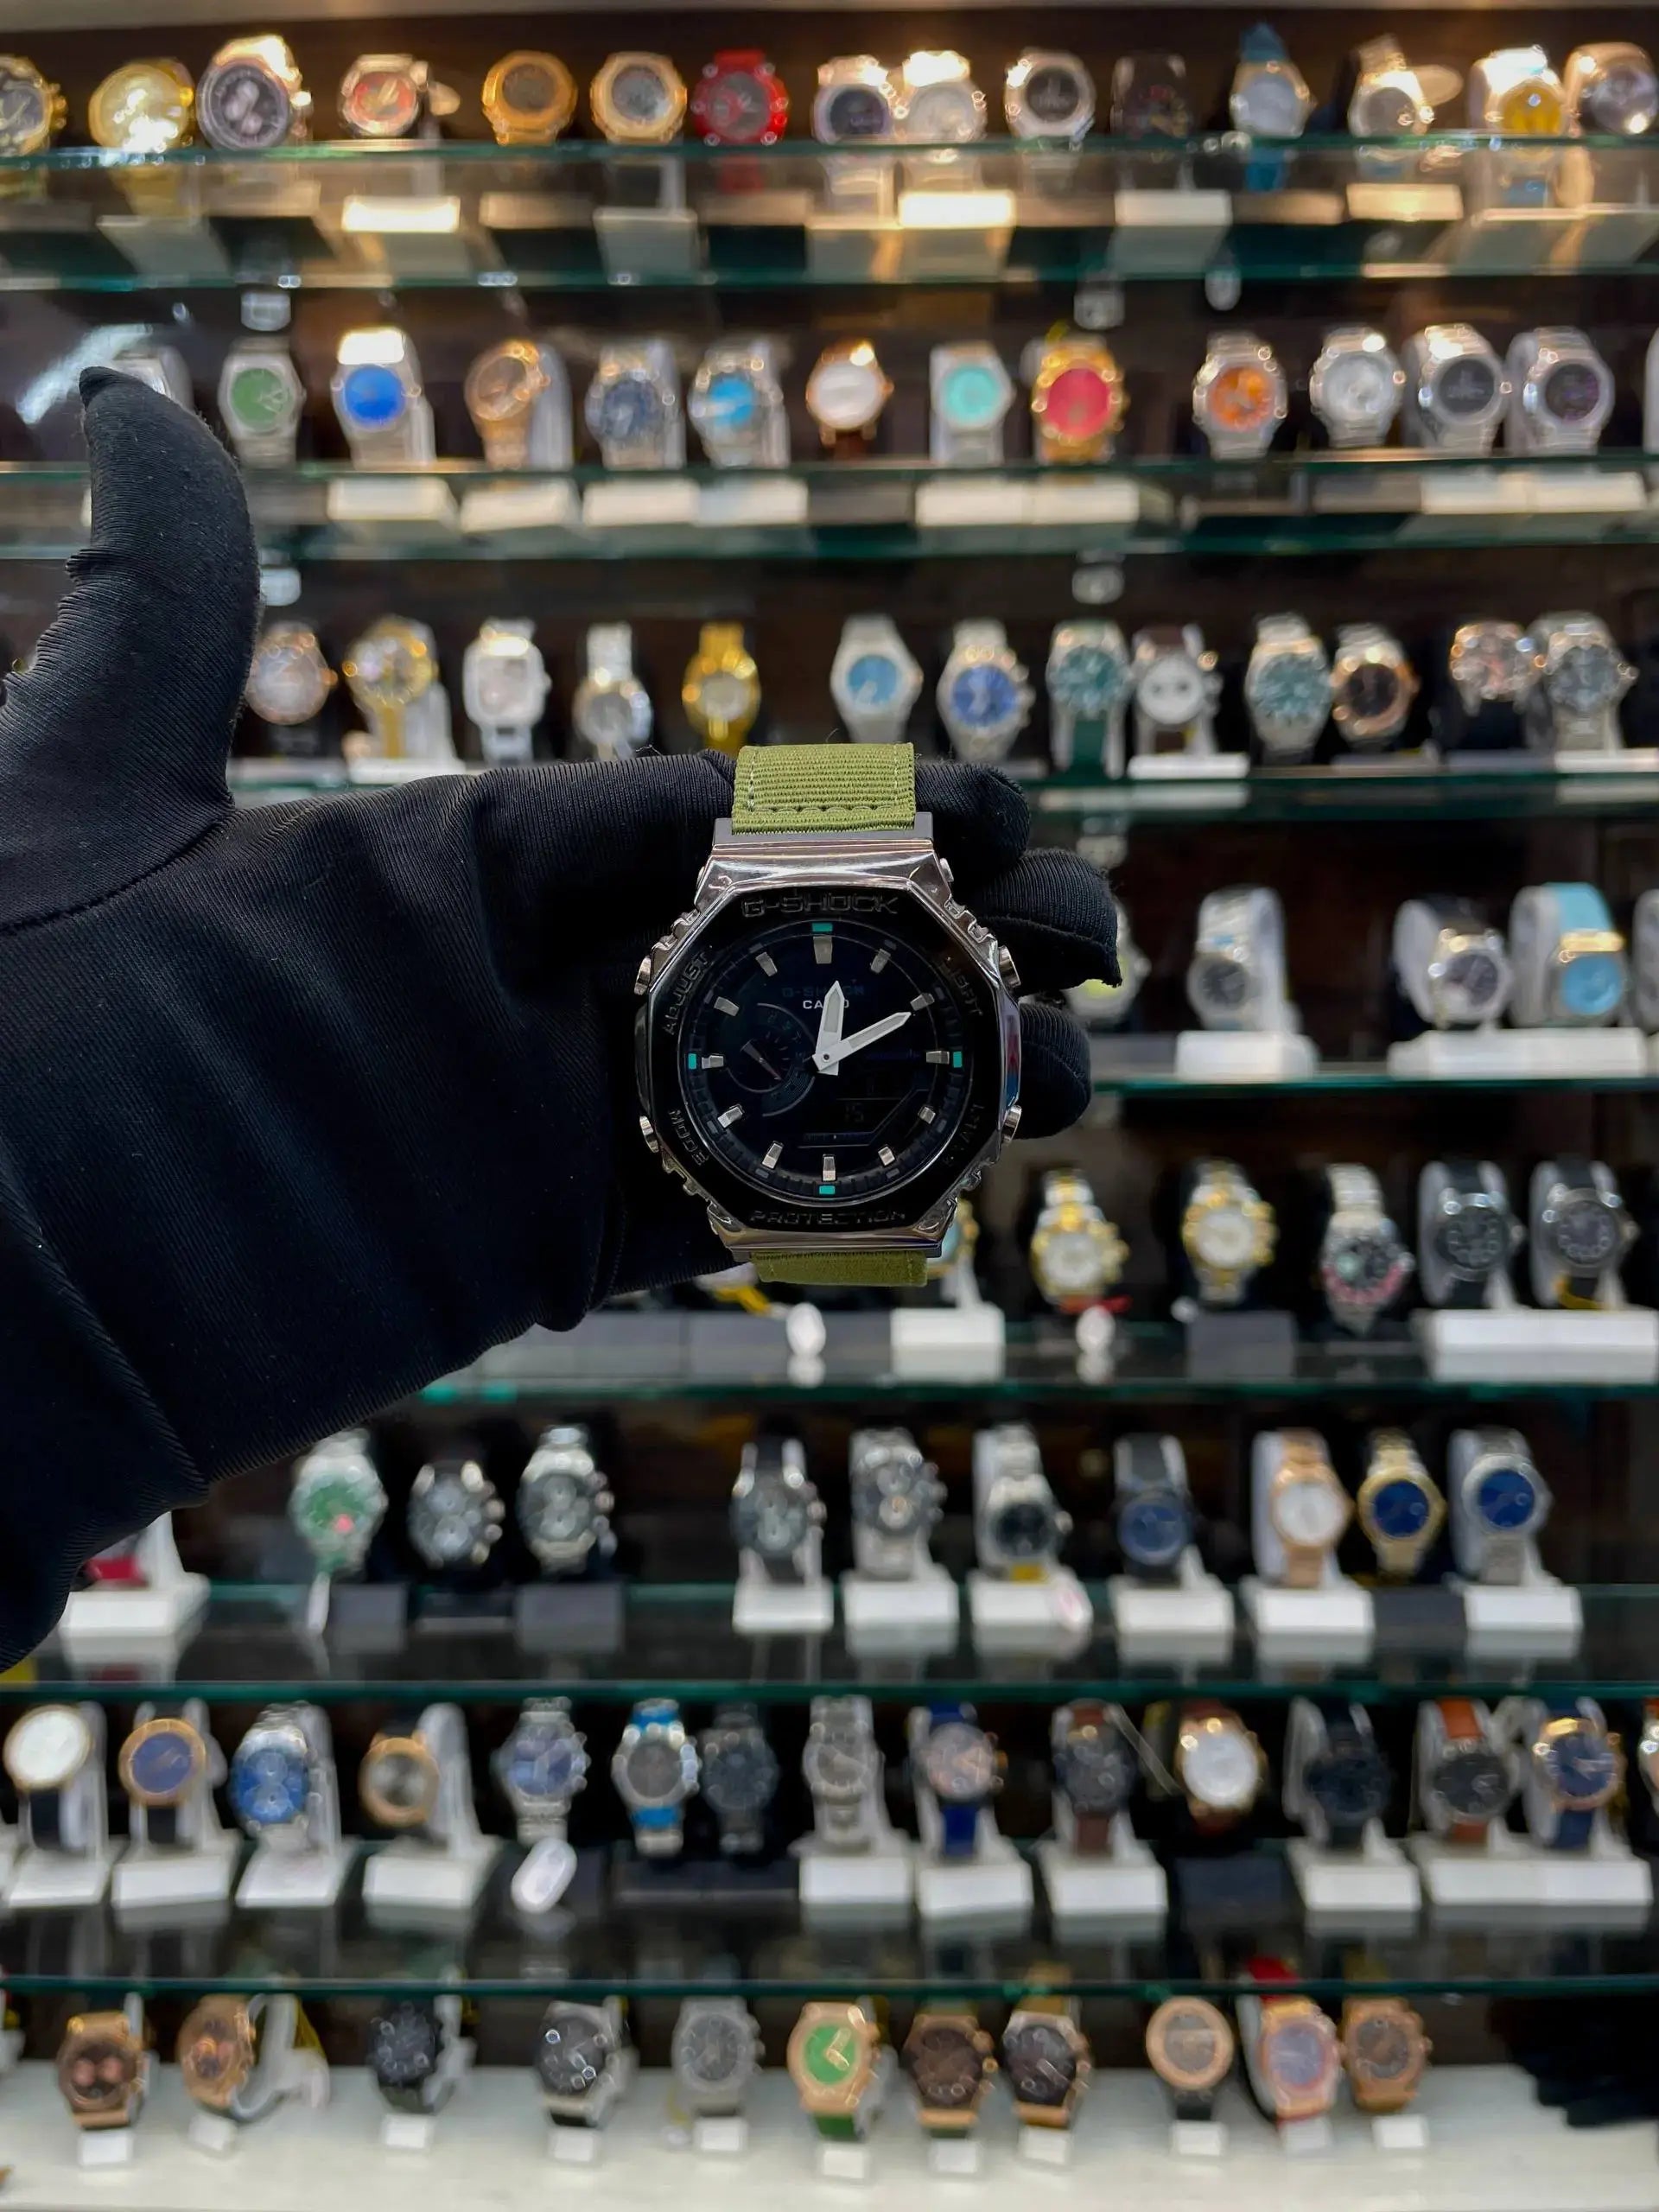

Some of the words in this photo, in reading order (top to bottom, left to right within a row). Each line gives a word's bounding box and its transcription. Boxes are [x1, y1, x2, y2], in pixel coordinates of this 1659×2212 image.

[741, 891, 899, 918] G-SHOCK
[661, 950, 709, 1035] ADJUST
[802, 999, 850, 1010] CAO
[668, 1109, 710, 1167] MODE
[748, 1209, 906, 1226] PROTECTION
